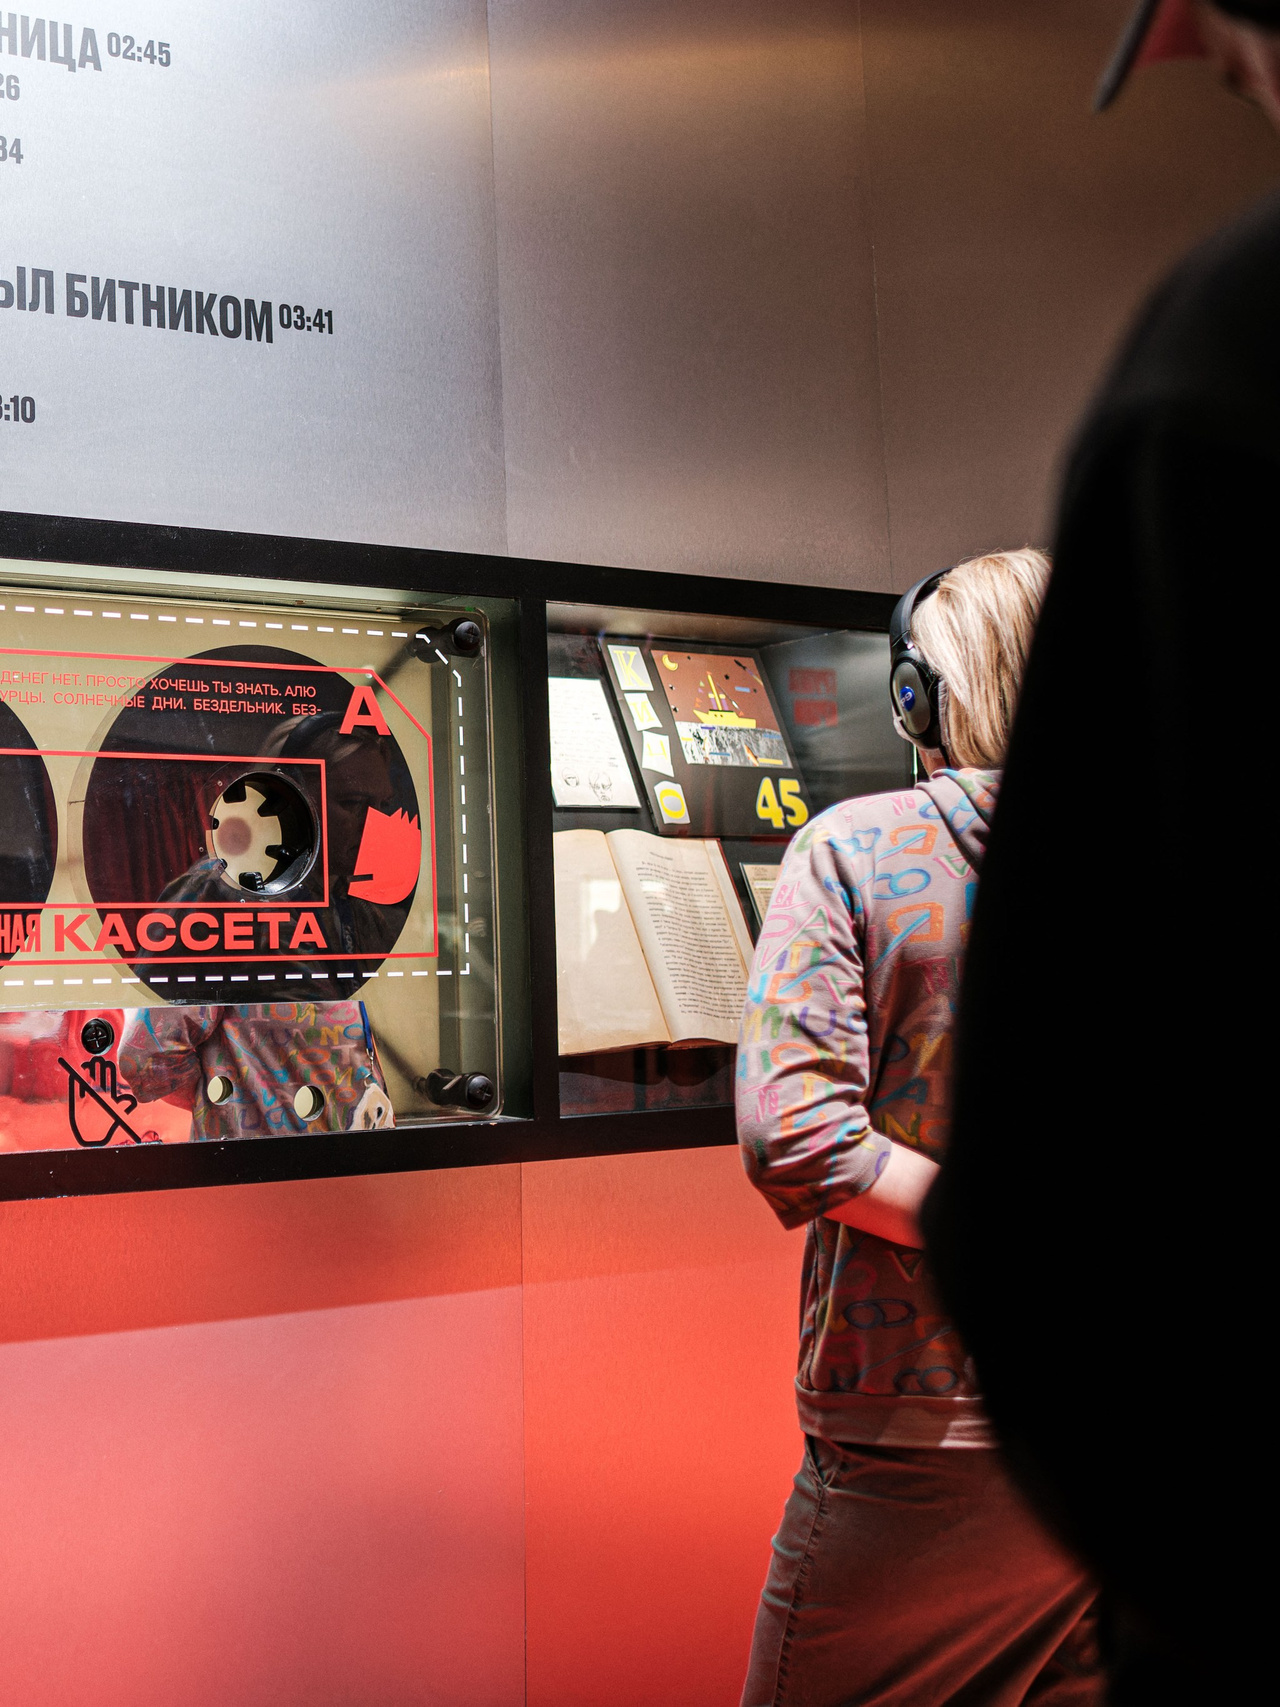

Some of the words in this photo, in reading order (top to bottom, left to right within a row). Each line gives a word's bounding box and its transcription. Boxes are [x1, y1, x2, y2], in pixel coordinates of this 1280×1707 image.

[107, 32, 171, 67] 02:45
[66, 272, 273, 344] БИТНИКОМ
[279, 303, 333, 335] 03:41
[0, 670, 49, 684] ДЕНЕГ
[52, 673, 82, 686] НЕТ.
[86, 675, 146, 689] ПРОСТО
[149, 678, 210, 693] ХОЧЕШЬ
[212, 681, 232, 694] ТЫ
[235, 682, 282, 696] ЗНАТЬ.
[285, 685, 316, 698] АЛЮ
[53, 692, 145, 708] СОЛНЕЧНЫЕ
[152, 696, 187, 711] ДНИ.
[193, 698, 286, 715] БЕЗДЕЛЬНИК.
[292, 703, 322, 716] БЕЗ-
[338, 685, 391, 736] А
[756, 776, 809, 829] 45
[53, 912, 328, 952] КАССЕТА
